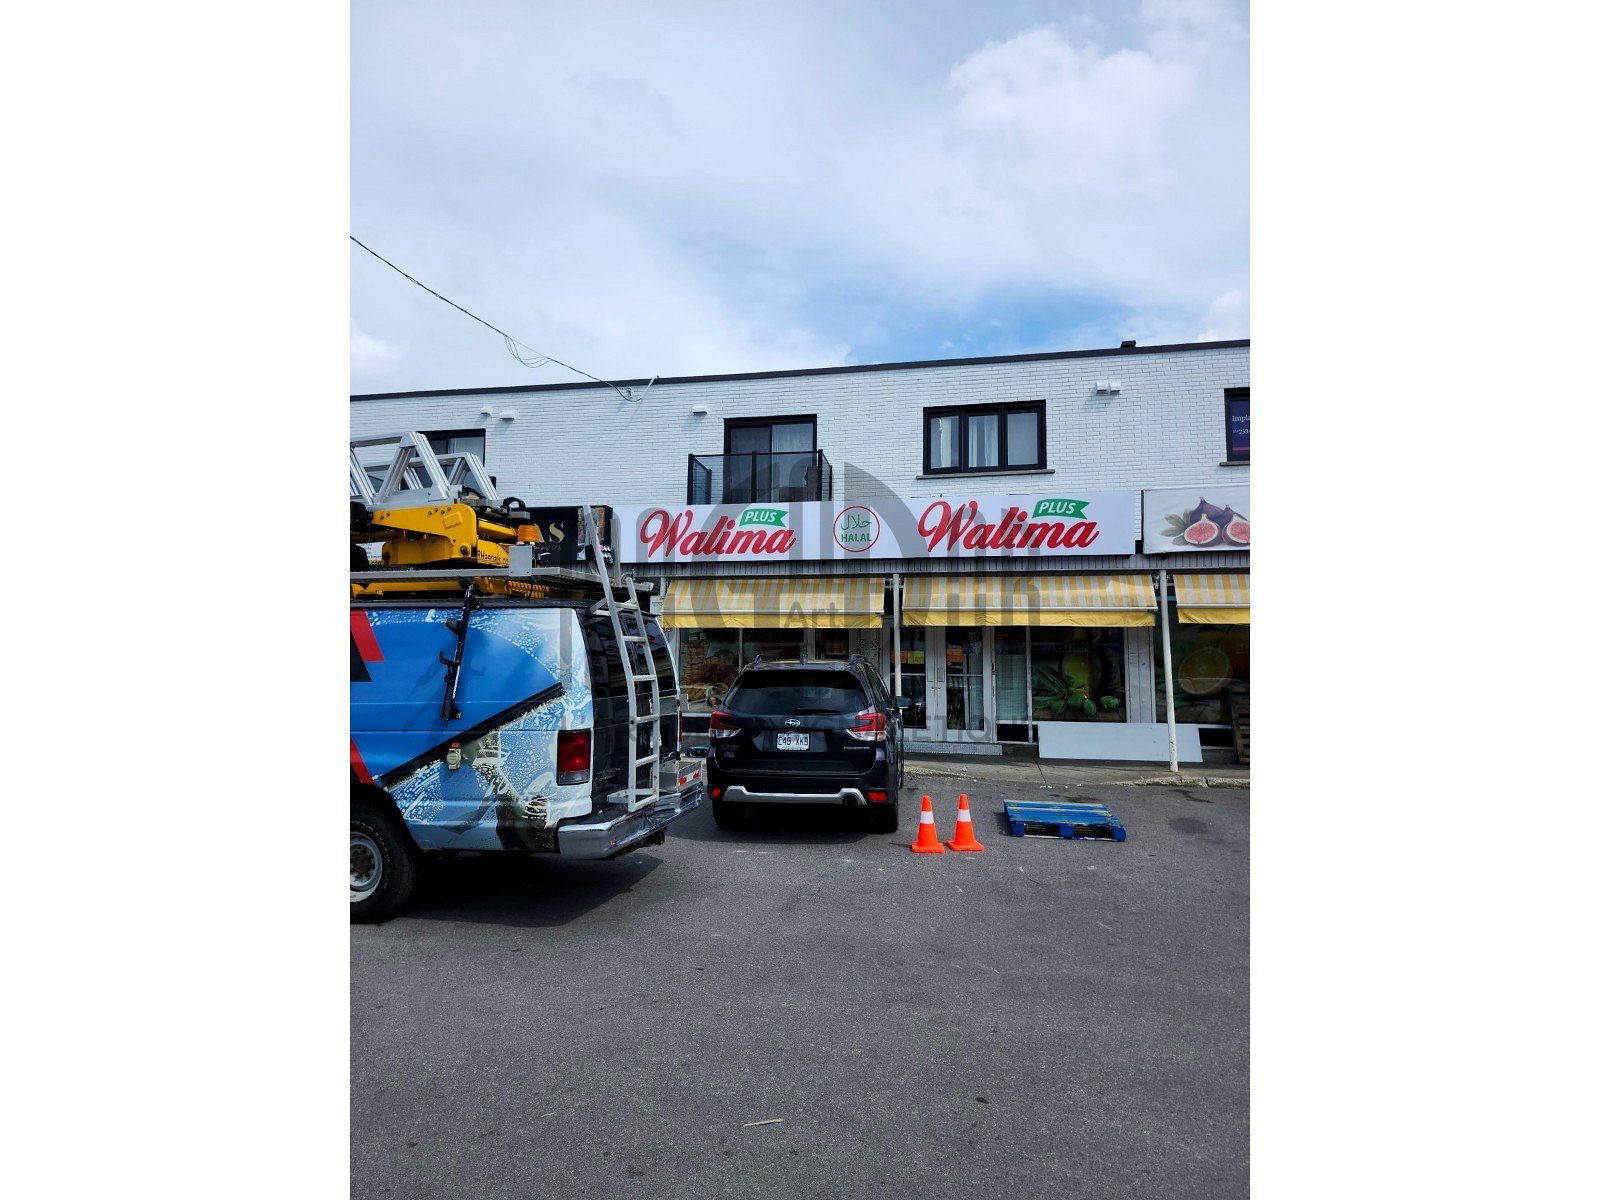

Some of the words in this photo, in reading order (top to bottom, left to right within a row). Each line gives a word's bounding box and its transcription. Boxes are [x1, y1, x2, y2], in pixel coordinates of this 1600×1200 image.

[1038, 501, 1077, 514] PLUS
[744, 510, 777, 523] PLUS
[840, 514, 873, 531] حلال
[639, 509, 797, 558] Walima
[917, 500, 1100, 552] Walima
[840, 532, 873, 543] HALAL
